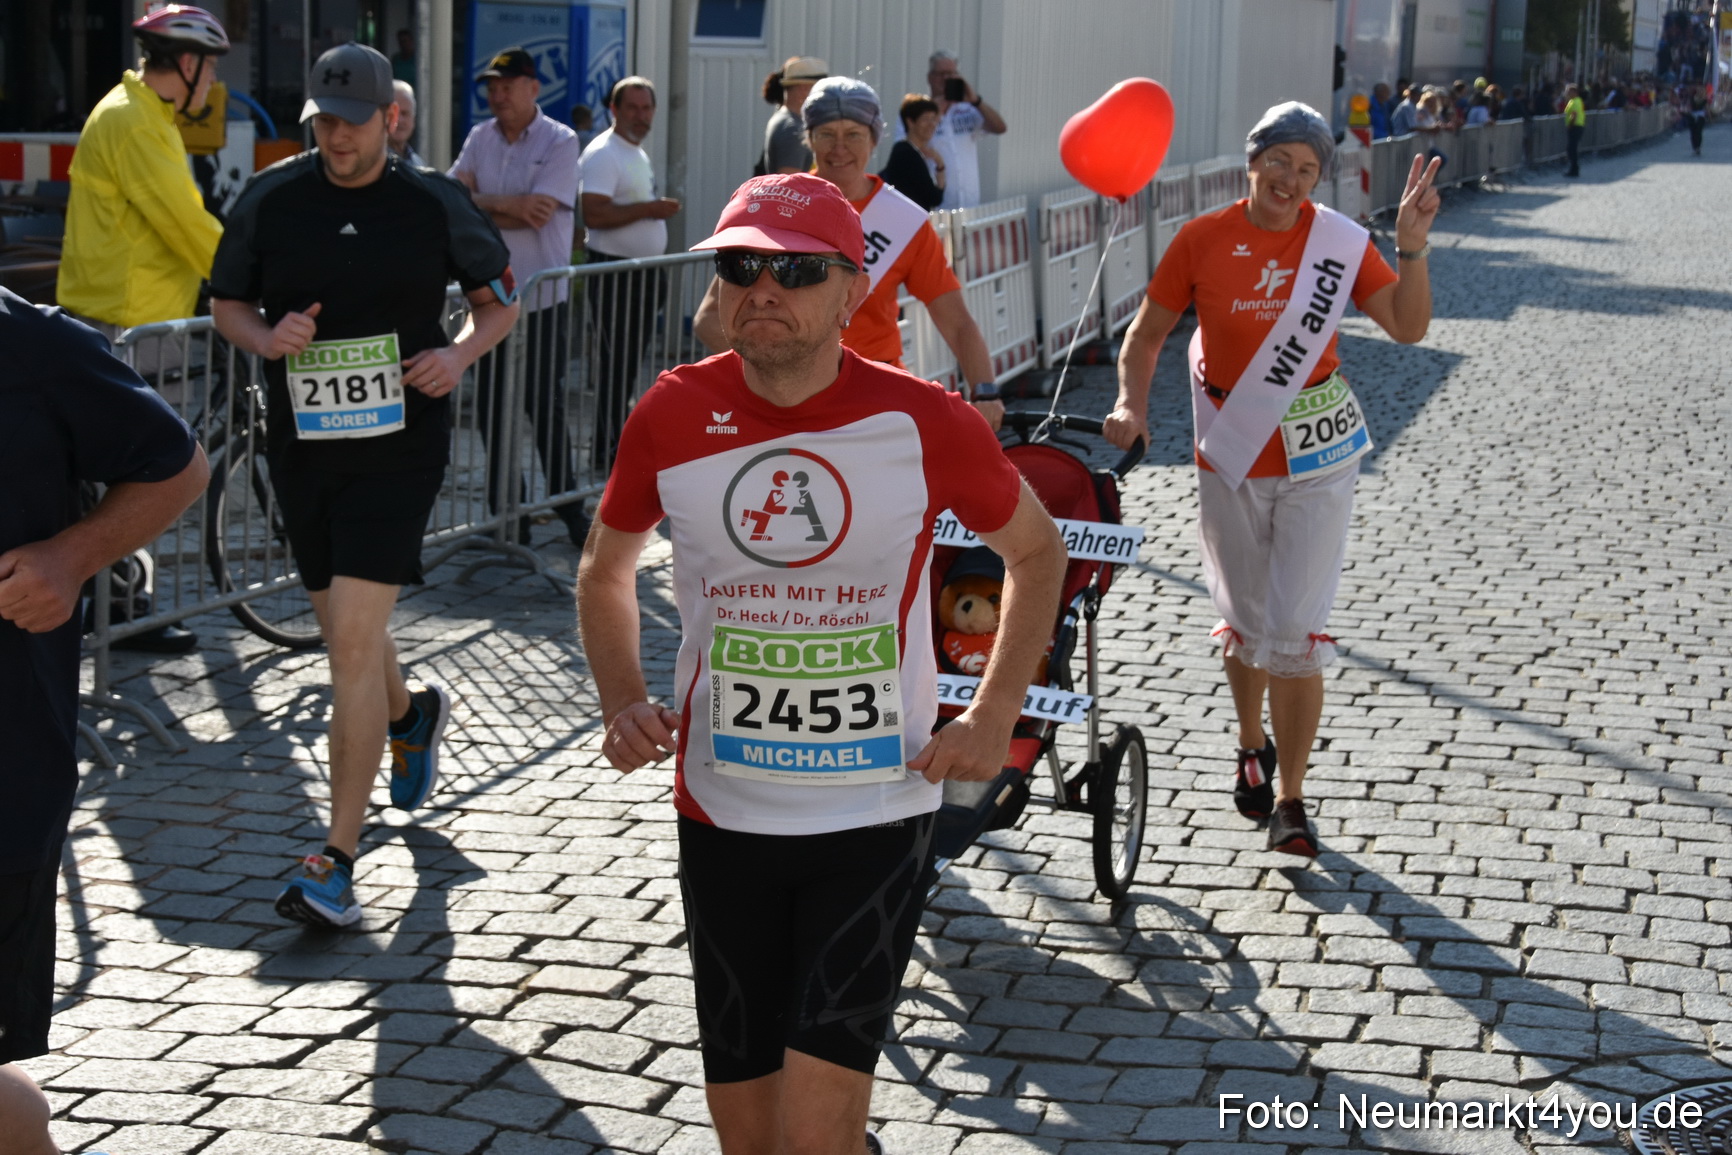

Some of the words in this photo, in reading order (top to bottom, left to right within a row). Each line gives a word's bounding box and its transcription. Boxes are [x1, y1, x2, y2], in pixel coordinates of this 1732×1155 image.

[1263, 335, 1308, 387] wir
[1301, 257, 1345, 334] auch
[297, 341, 391, 369] BOCK
[302, 372, 387, 406] 2181
[320, 412, 378, 428] SÖREN
[706, 424, 738, 434] erima
[1295, 402, 1357, 450] 2069
[1318, 440, 1355, 465] LUISE
[787, 585, 826, 602] MIT
[717, 607, 736, 621] Dr.
[740, 609, 778, 624] Heck
[793, 612, 814, 627] Dr.
[819, 612, 869, 627] Röschl
[723, 632, 885, 674] BOCK
[883, 683, 891, 692] C
[732, 682, 880, 734] 2453
[742, 744, 872, 768] MICHAEL
